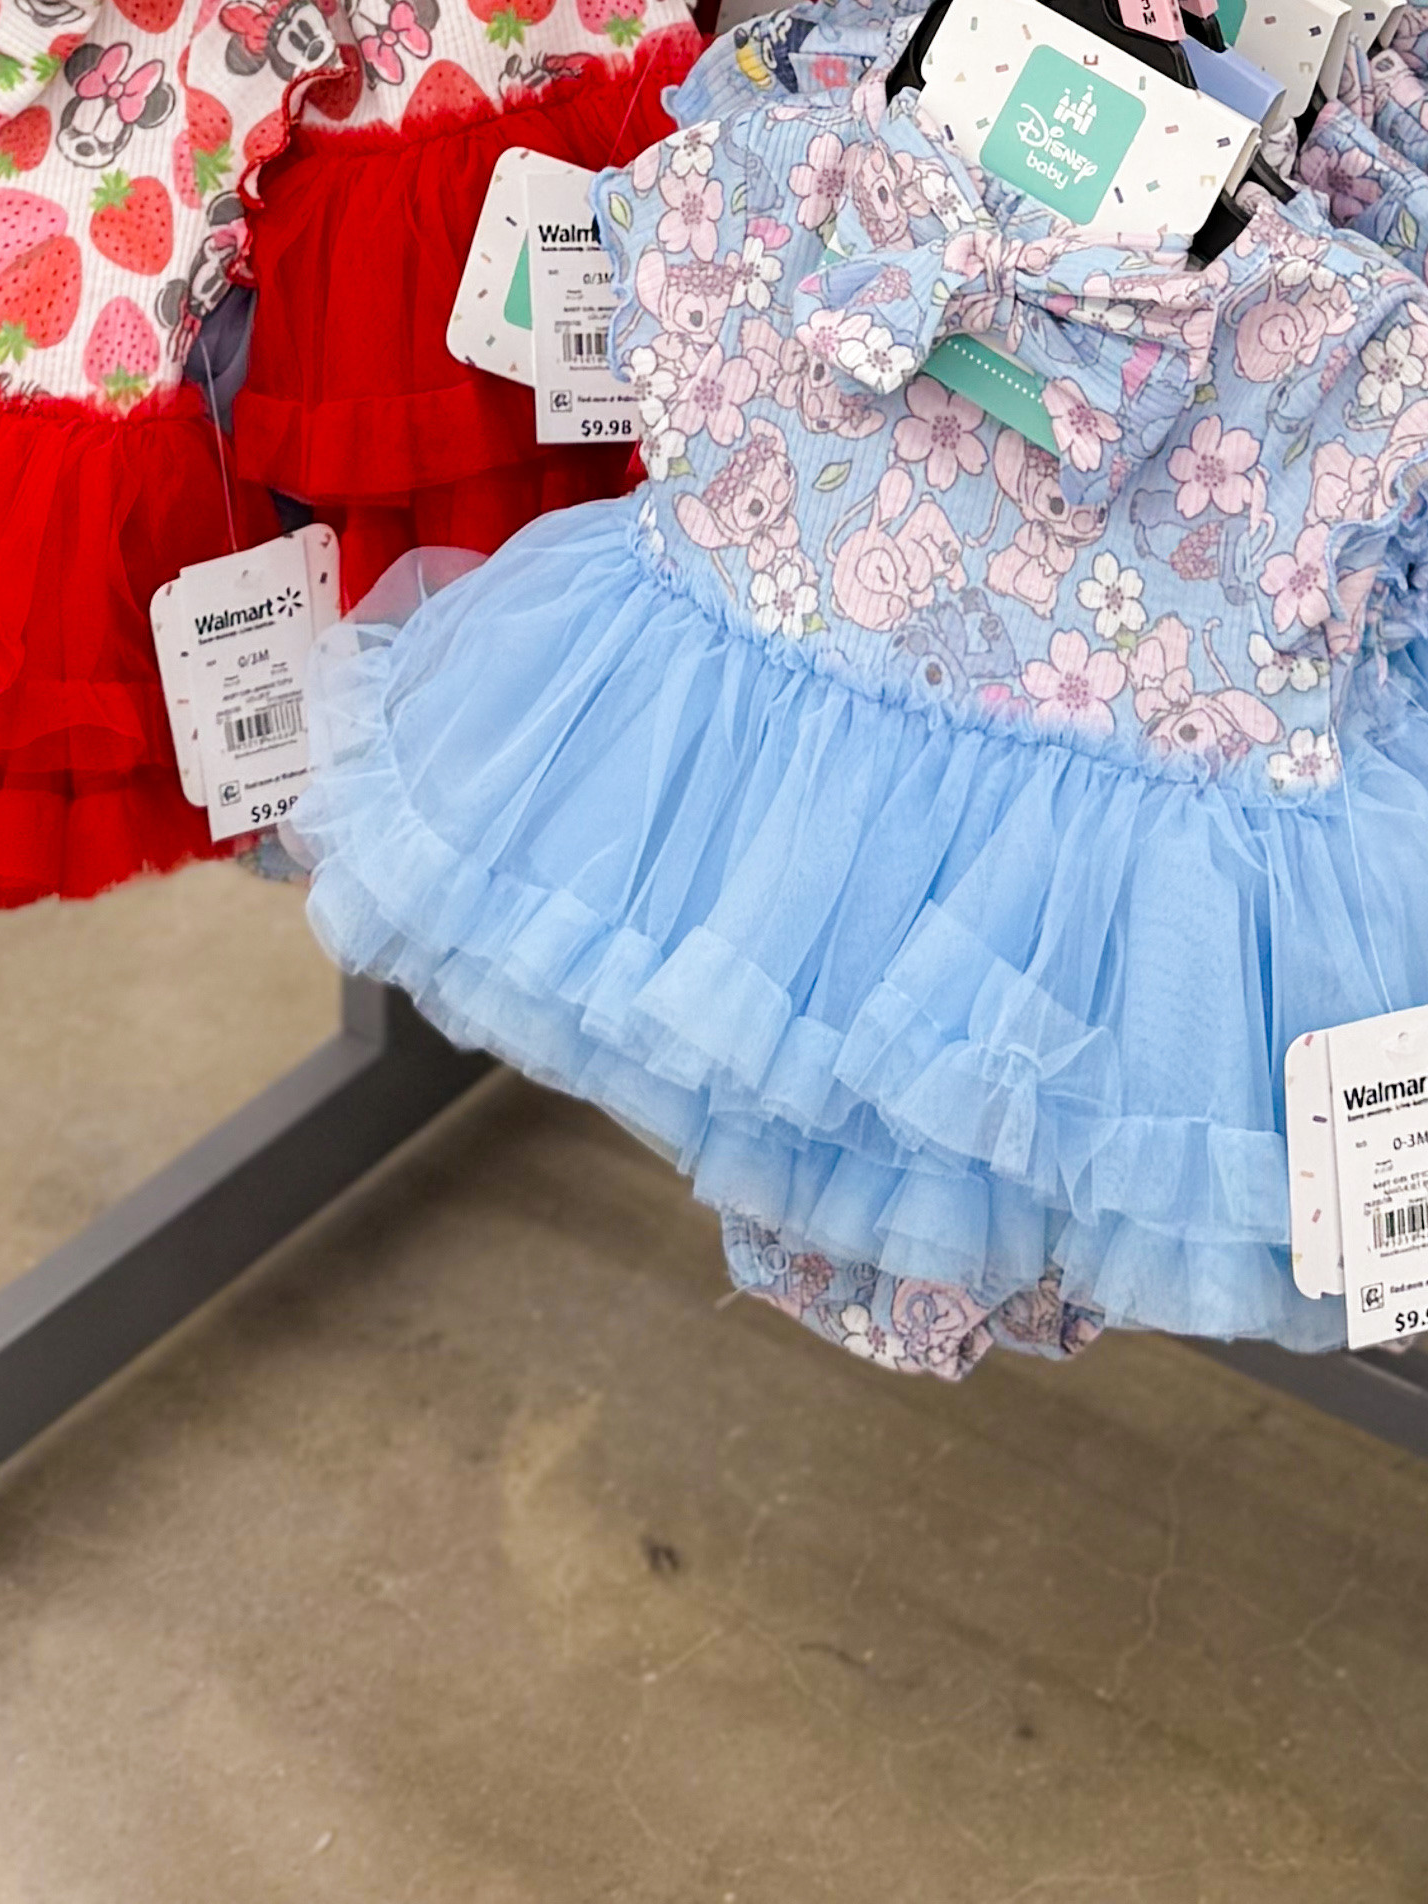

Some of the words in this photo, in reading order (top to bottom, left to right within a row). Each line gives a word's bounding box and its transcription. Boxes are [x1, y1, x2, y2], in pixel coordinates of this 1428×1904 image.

[1016, 102, 1098, 184] Disney
[1025, 149, 1070, 190] baby
[538, 224, 598, 243] Walm
[581, 419, 632, 437] $9.98
[195, 598, 274, 636] Walmart
